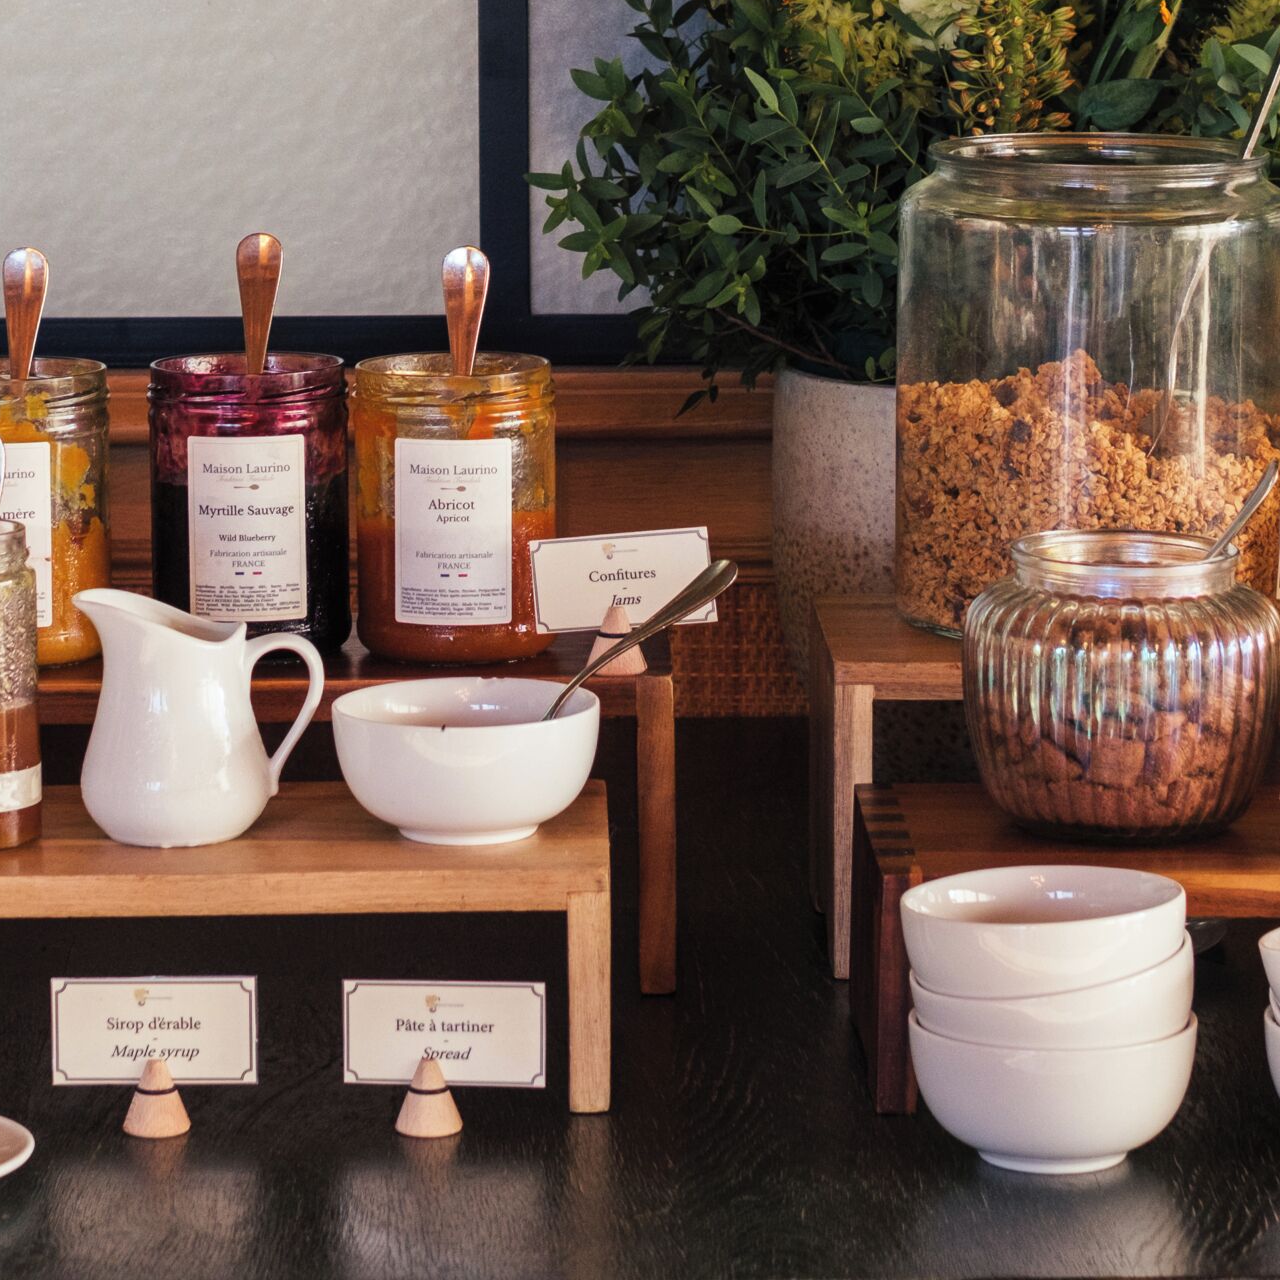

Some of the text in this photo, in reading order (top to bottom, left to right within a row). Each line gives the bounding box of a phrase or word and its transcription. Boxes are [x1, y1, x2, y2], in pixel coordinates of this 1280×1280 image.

[202, 462, 291, 474] Maison Laurino
[410, 464, 498, 475] Maison Laurino
[4, 469, 36, 479] urino
[428, 499, 475, 510] Abricot
[199, 505, 295, 518] Myrtille Sauvage
[436, 514, 470, 524] Apricot
[219, 534, 276, 542] Wild Blueberry
[209, 548, 287, 558] Fabrication artisanale
[415, 551, 494, 559] Fabrication artisanale
[232, 560, 265, 568] FRANCE
[589, 568, 656, 583] Confitures
[611, 594, 642, 608] Jams
[107, 1017, 201, 1033] Sirop d'érable
[396, 1018, 494, 1033] Pâte à tartiner
[111, 1045, 200, 1061] Maple syrup
[422, 1046, 472, 1060] Spread
